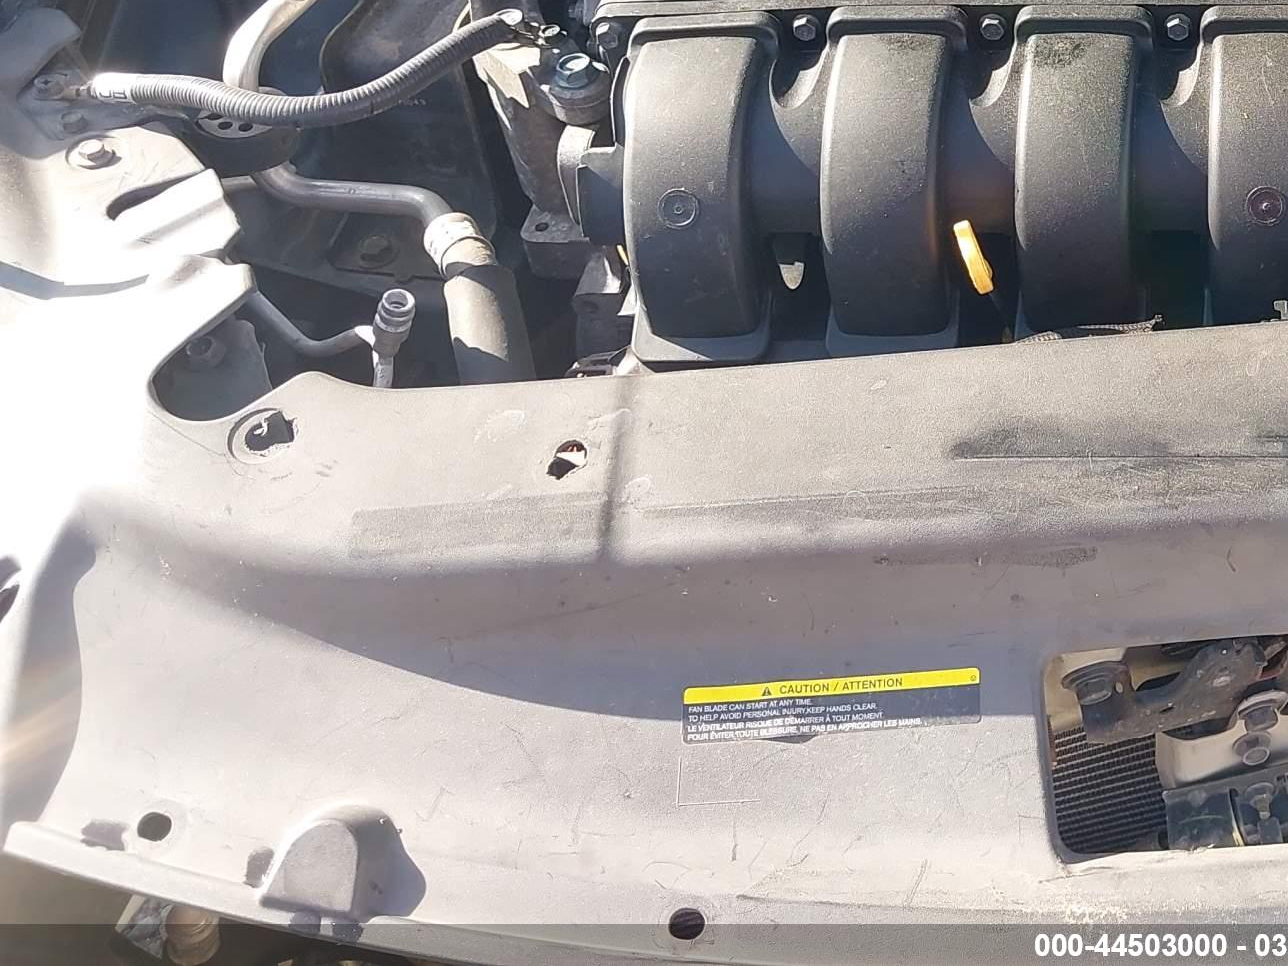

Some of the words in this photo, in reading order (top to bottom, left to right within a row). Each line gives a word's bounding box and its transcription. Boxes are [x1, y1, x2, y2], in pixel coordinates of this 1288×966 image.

[780, 684, 829, 694] CAUTION
[842, 678, 903, 690] ATTENTION
[701, 713, 718, 721] HELP
[720, 712, 742, 720] AVOID
[743, 709, 780, 719] PERSONAL
[826, 704, 851, 712] HANDS
[729, 703, 745, 711] CAN
[746, 702, 768, 710] START
[688, 724, 697, 732] LE
[698, 721, 744, 731] VENTILATEUR
[746, 719, 772, 728] RISQUE
[833, 713, 851, 721] TOUT
[688, 733, 709, 741] POUR
[838, 721, 882, 731] APPROCHER
[884, 719, 897, 727] LES
